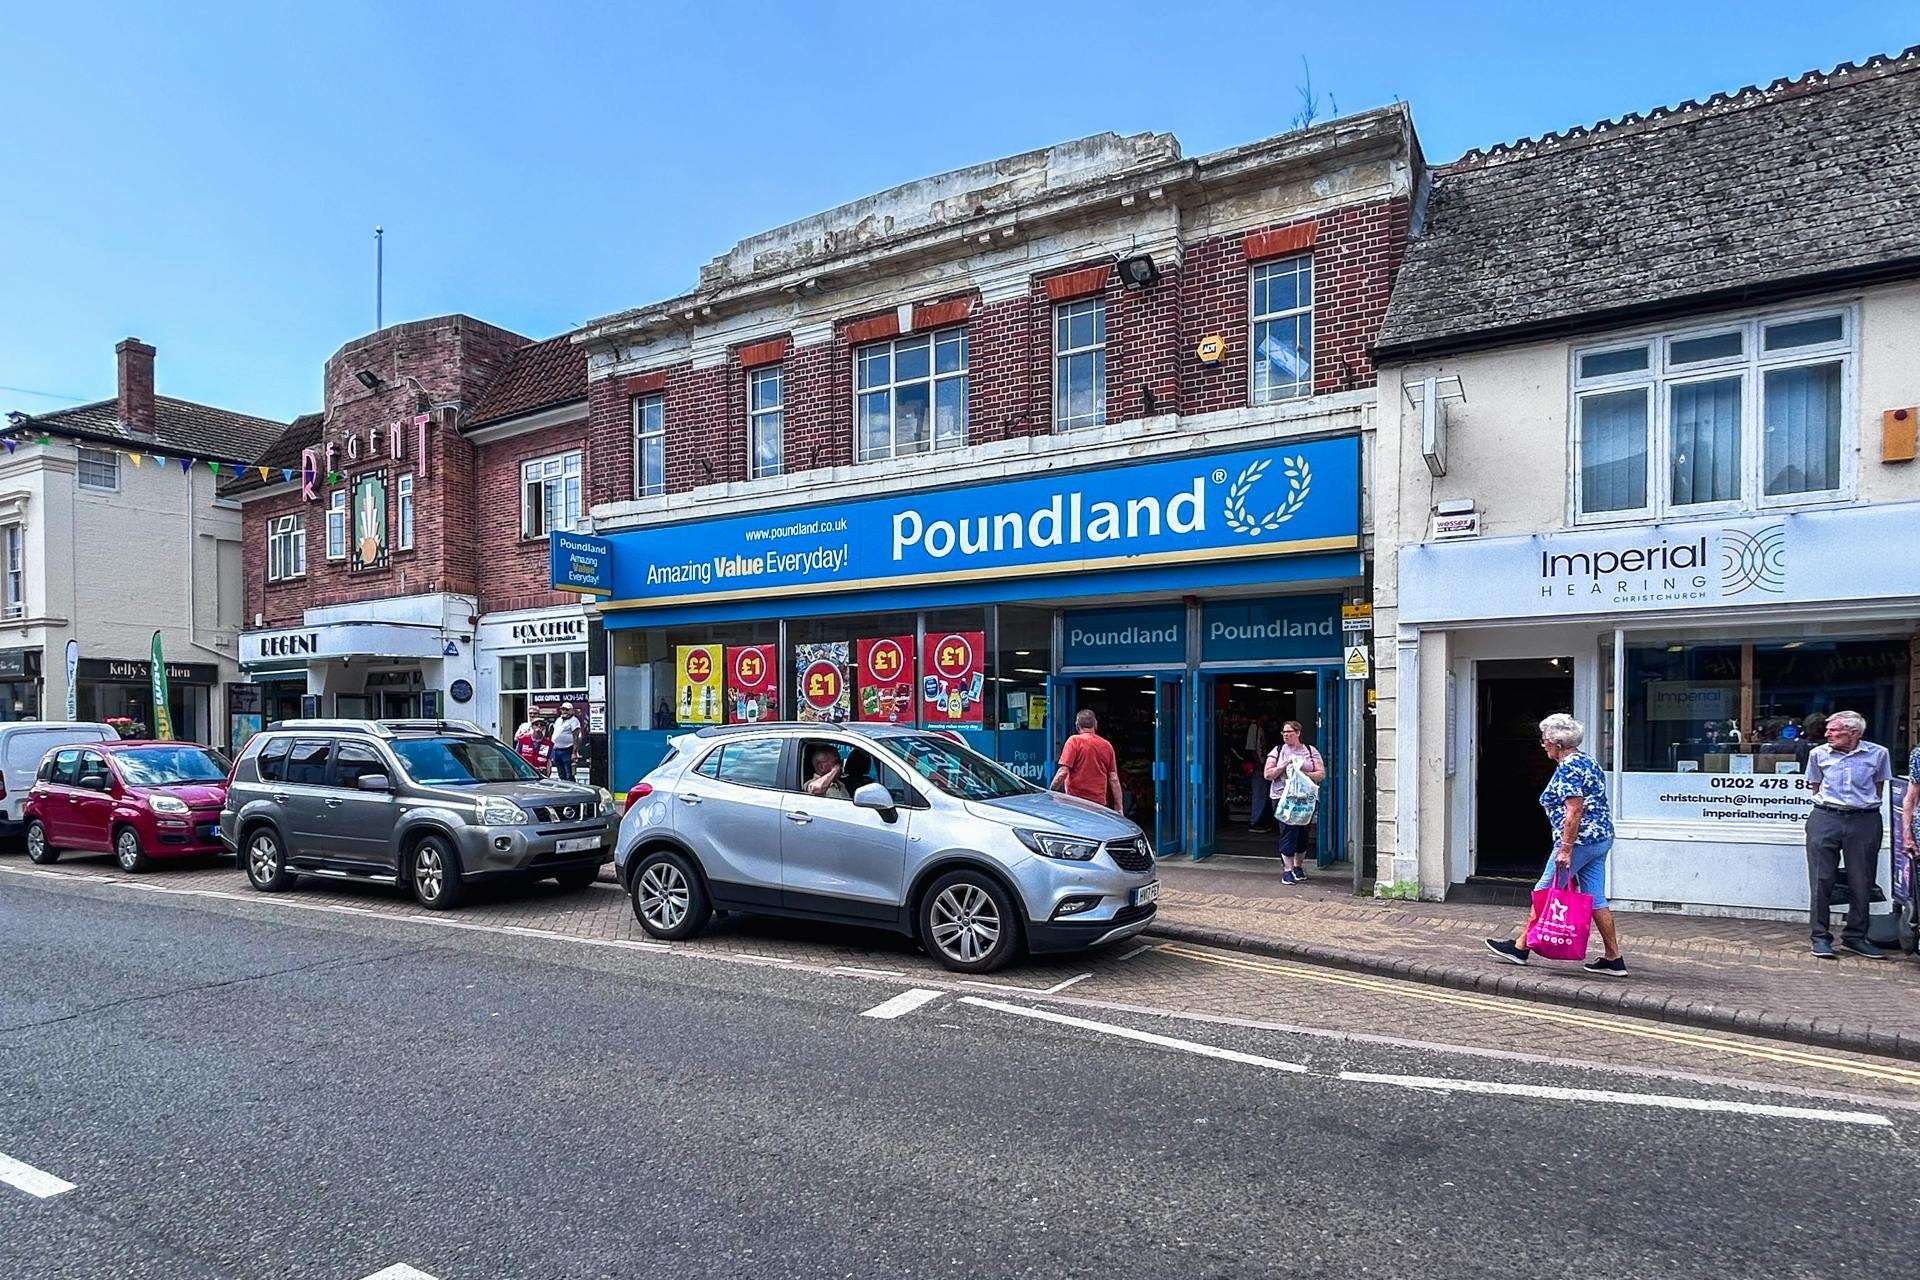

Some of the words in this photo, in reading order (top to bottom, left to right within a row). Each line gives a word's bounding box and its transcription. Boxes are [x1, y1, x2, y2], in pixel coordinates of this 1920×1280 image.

[302, 413, 430, 502] REGENT
[892, 477, 1206, 561] Poundland
[745, 517, 848, 542] www.poundland.co.uk
[560, 538, 607, 555] Poundland
[570, 553, 598, 567] Amazing
[646, 560, 711, 585] Amazing
[713, 552, 763, 578] Value
[766, 543, 848, 575] Everyday!
[1541, 536, 1706, 580] Imperial
[1541, 576, 1706, 597] HEARING
[1613, 592, 1706, 603] CHRISTCHURCH
[512, 625, 538, 639] BOX
[540, 620, 585, 637] OFFICE
[1071, 625, 1178, 647] Poundland
[1211, 617, 1334, 640] Poundland
[261, 633, 319, 657] REGENT
[688, 657, 710, 674] £2
[874, 650, 897, 670] £1
[940, 646, 965, 666] £1
[110, 662, 147, 679] Kelly's
[165, 665, 191, 678] chen
[741, 657, 761, 676] £1
[809, 673, 835, 696] £1
[1657, 689, 1721, 704] Imperial
[1710, 777, 1754, 789] 01202
[1759, 778, 1788, 790] 478
[1794, 778, 1813, 790] 88
[1659, 793, 1813, 806] christchurch@imperialhe
[1702, 808, 1808, 822] imperialhearing.c
